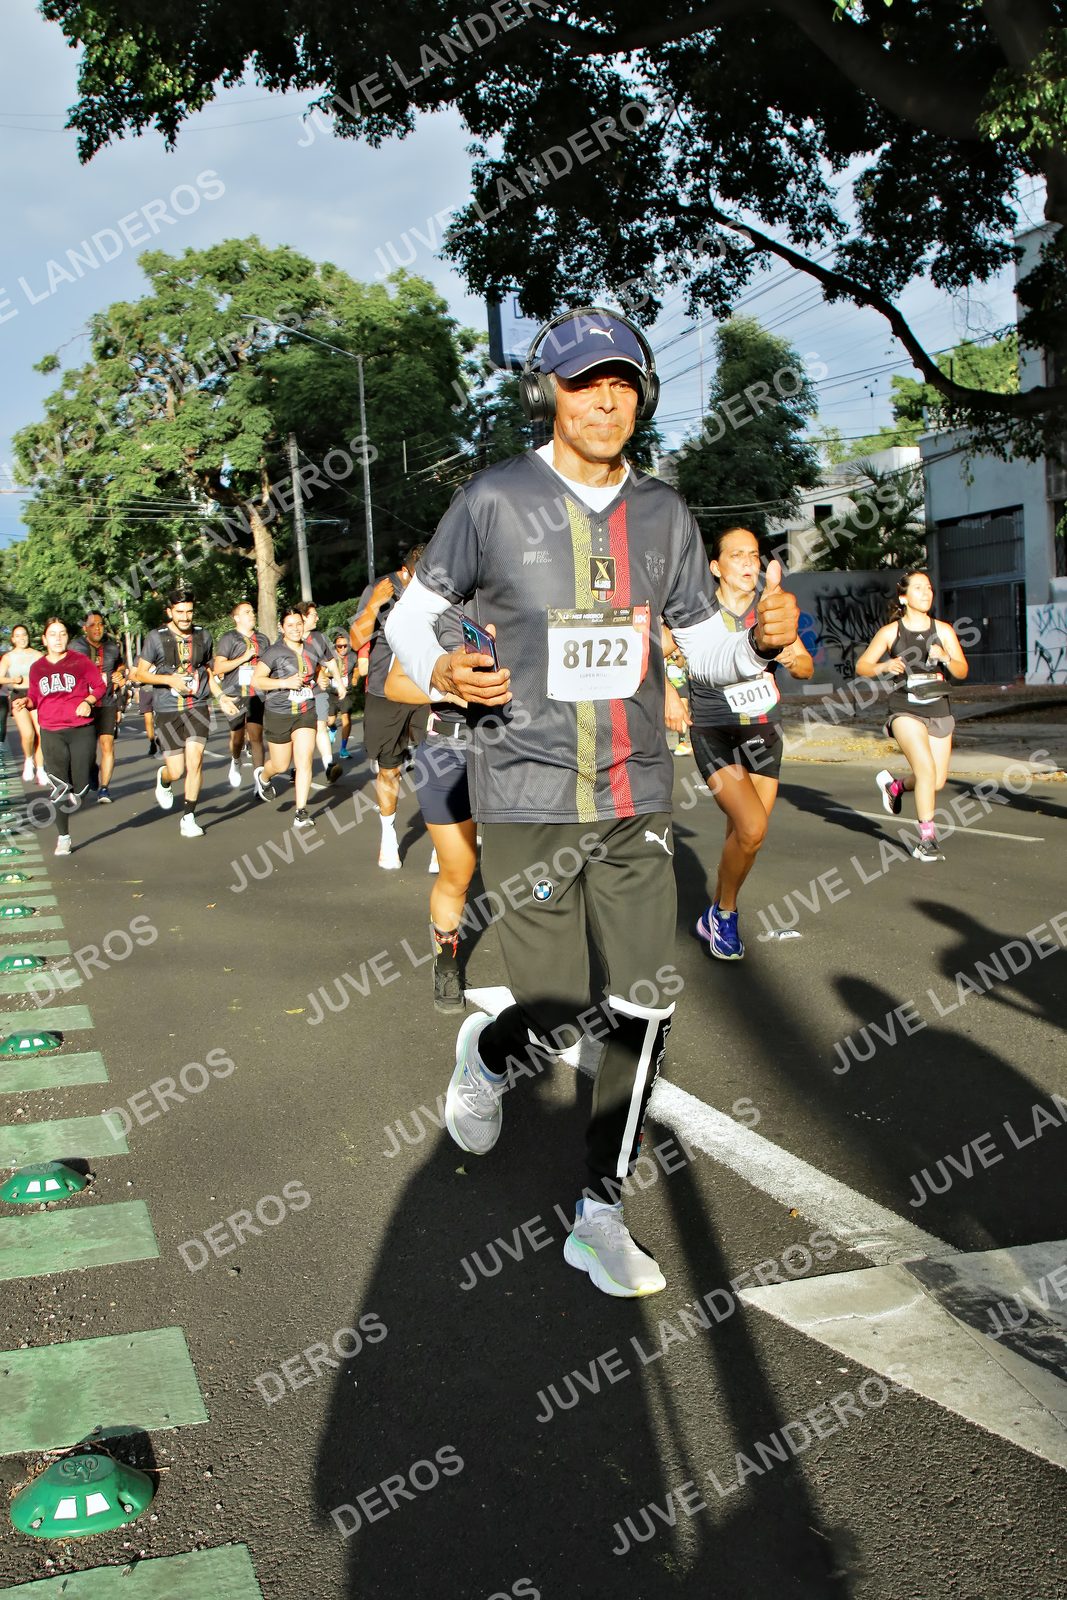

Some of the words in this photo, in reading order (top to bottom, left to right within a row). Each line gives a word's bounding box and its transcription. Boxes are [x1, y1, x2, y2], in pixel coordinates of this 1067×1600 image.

[563, 638, 628, 668] 8122
[39, 673, 76, 696] GAP
[729, 685, 771, 706] 13011
